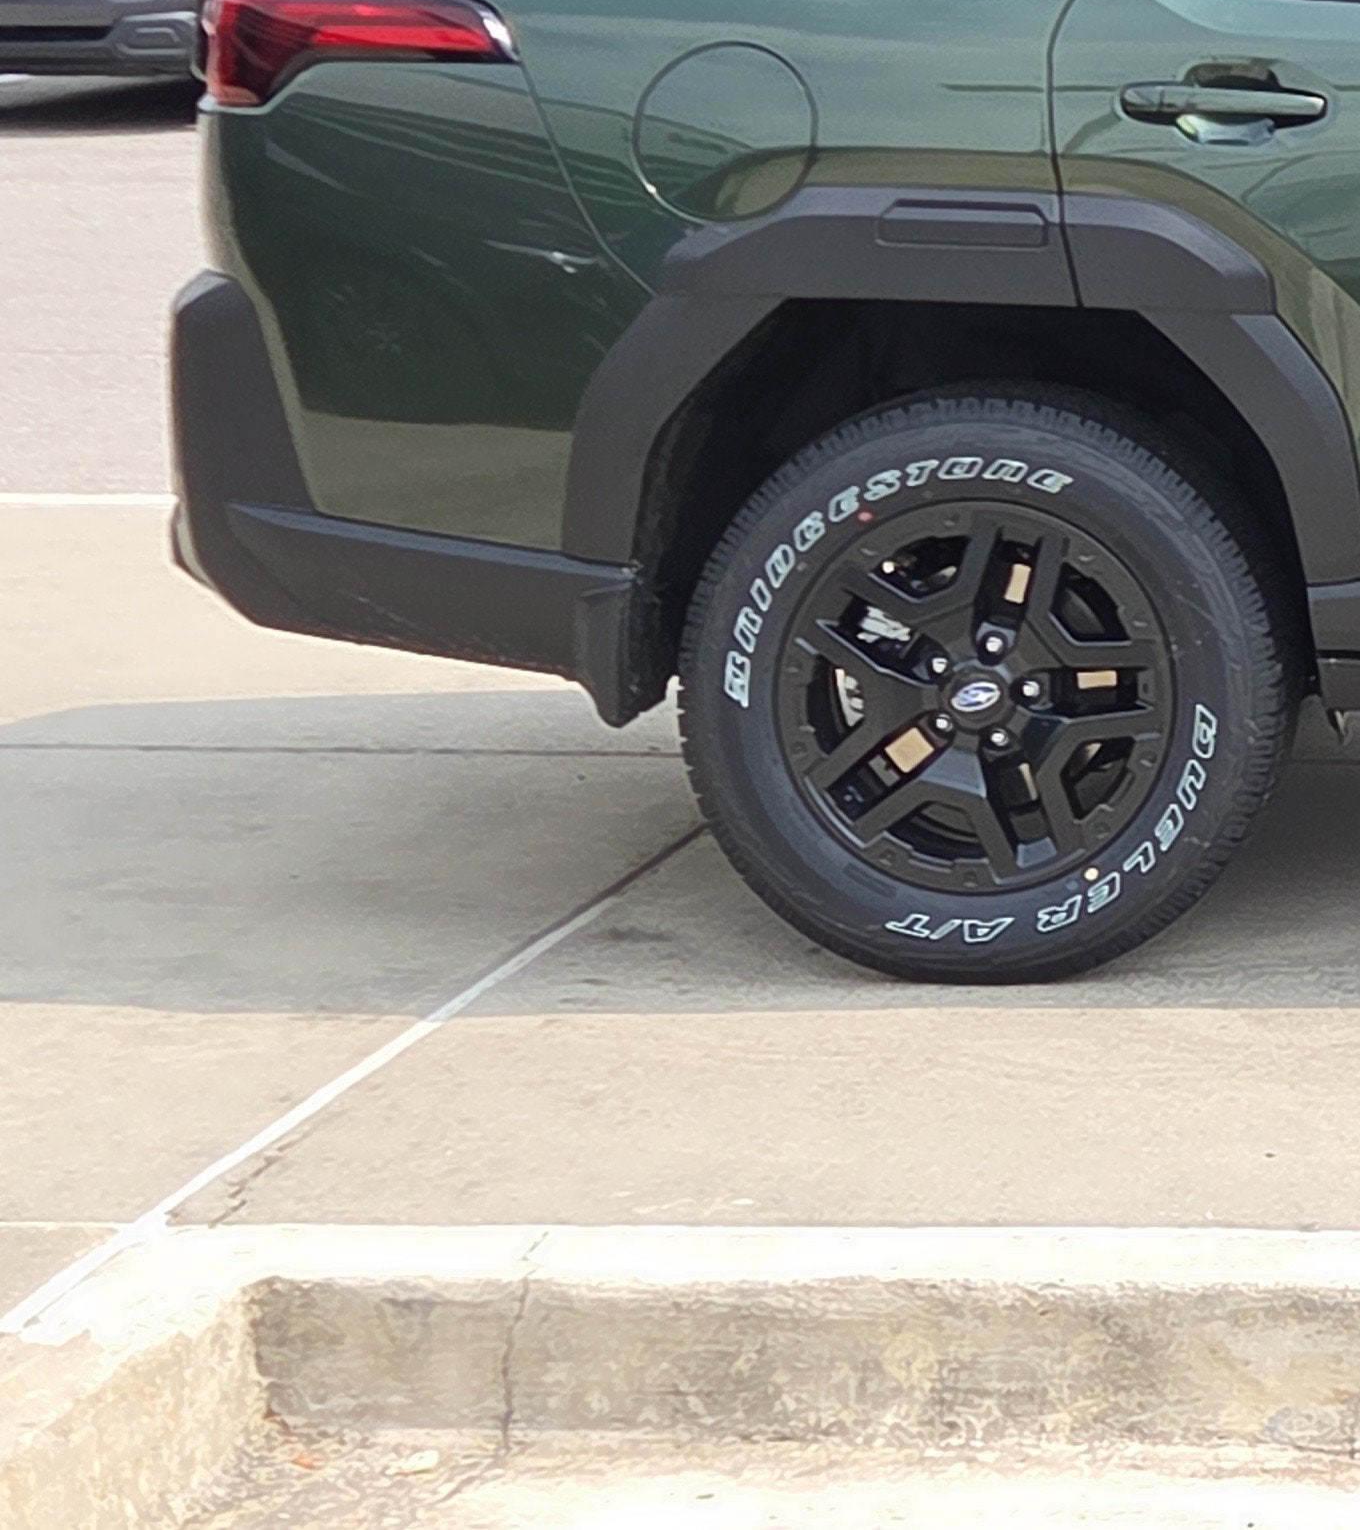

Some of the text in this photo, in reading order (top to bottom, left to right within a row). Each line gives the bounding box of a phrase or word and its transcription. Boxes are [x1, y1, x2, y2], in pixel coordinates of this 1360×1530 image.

[725, 457, 1073, 707] BRIDGESTONE
[886, 704, 1217, 943] DUELER A/T
